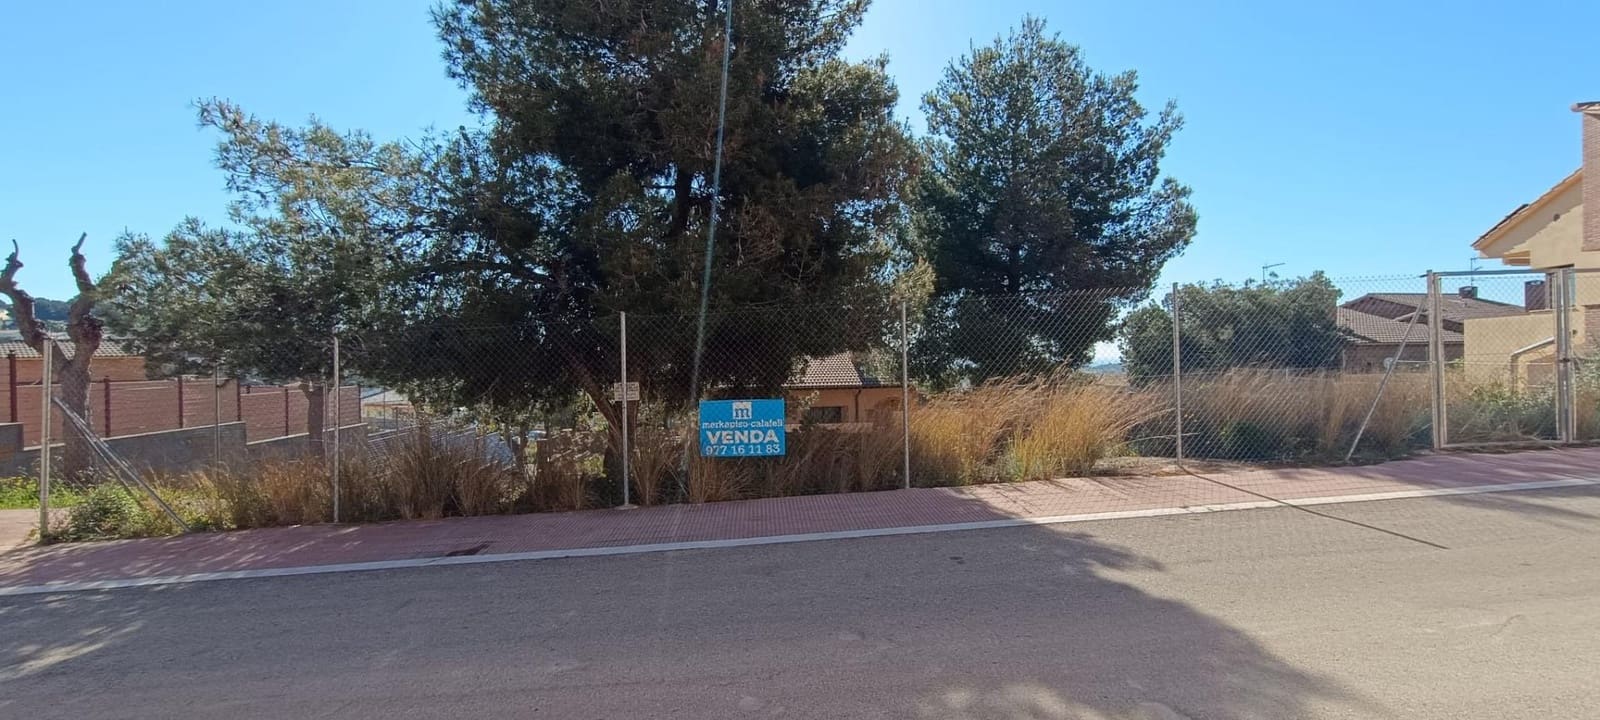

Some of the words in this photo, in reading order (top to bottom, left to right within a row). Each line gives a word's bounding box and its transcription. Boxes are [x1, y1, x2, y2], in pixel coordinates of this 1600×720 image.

[734, 408, 750, 418] m
[706, 429, 780, 445] VENDA
[706, 445, 728, 455] 977
[731, 445, 745, 455] 16
[748, 445, 762, 454] 11
[766, 444, 780, 454] 83
